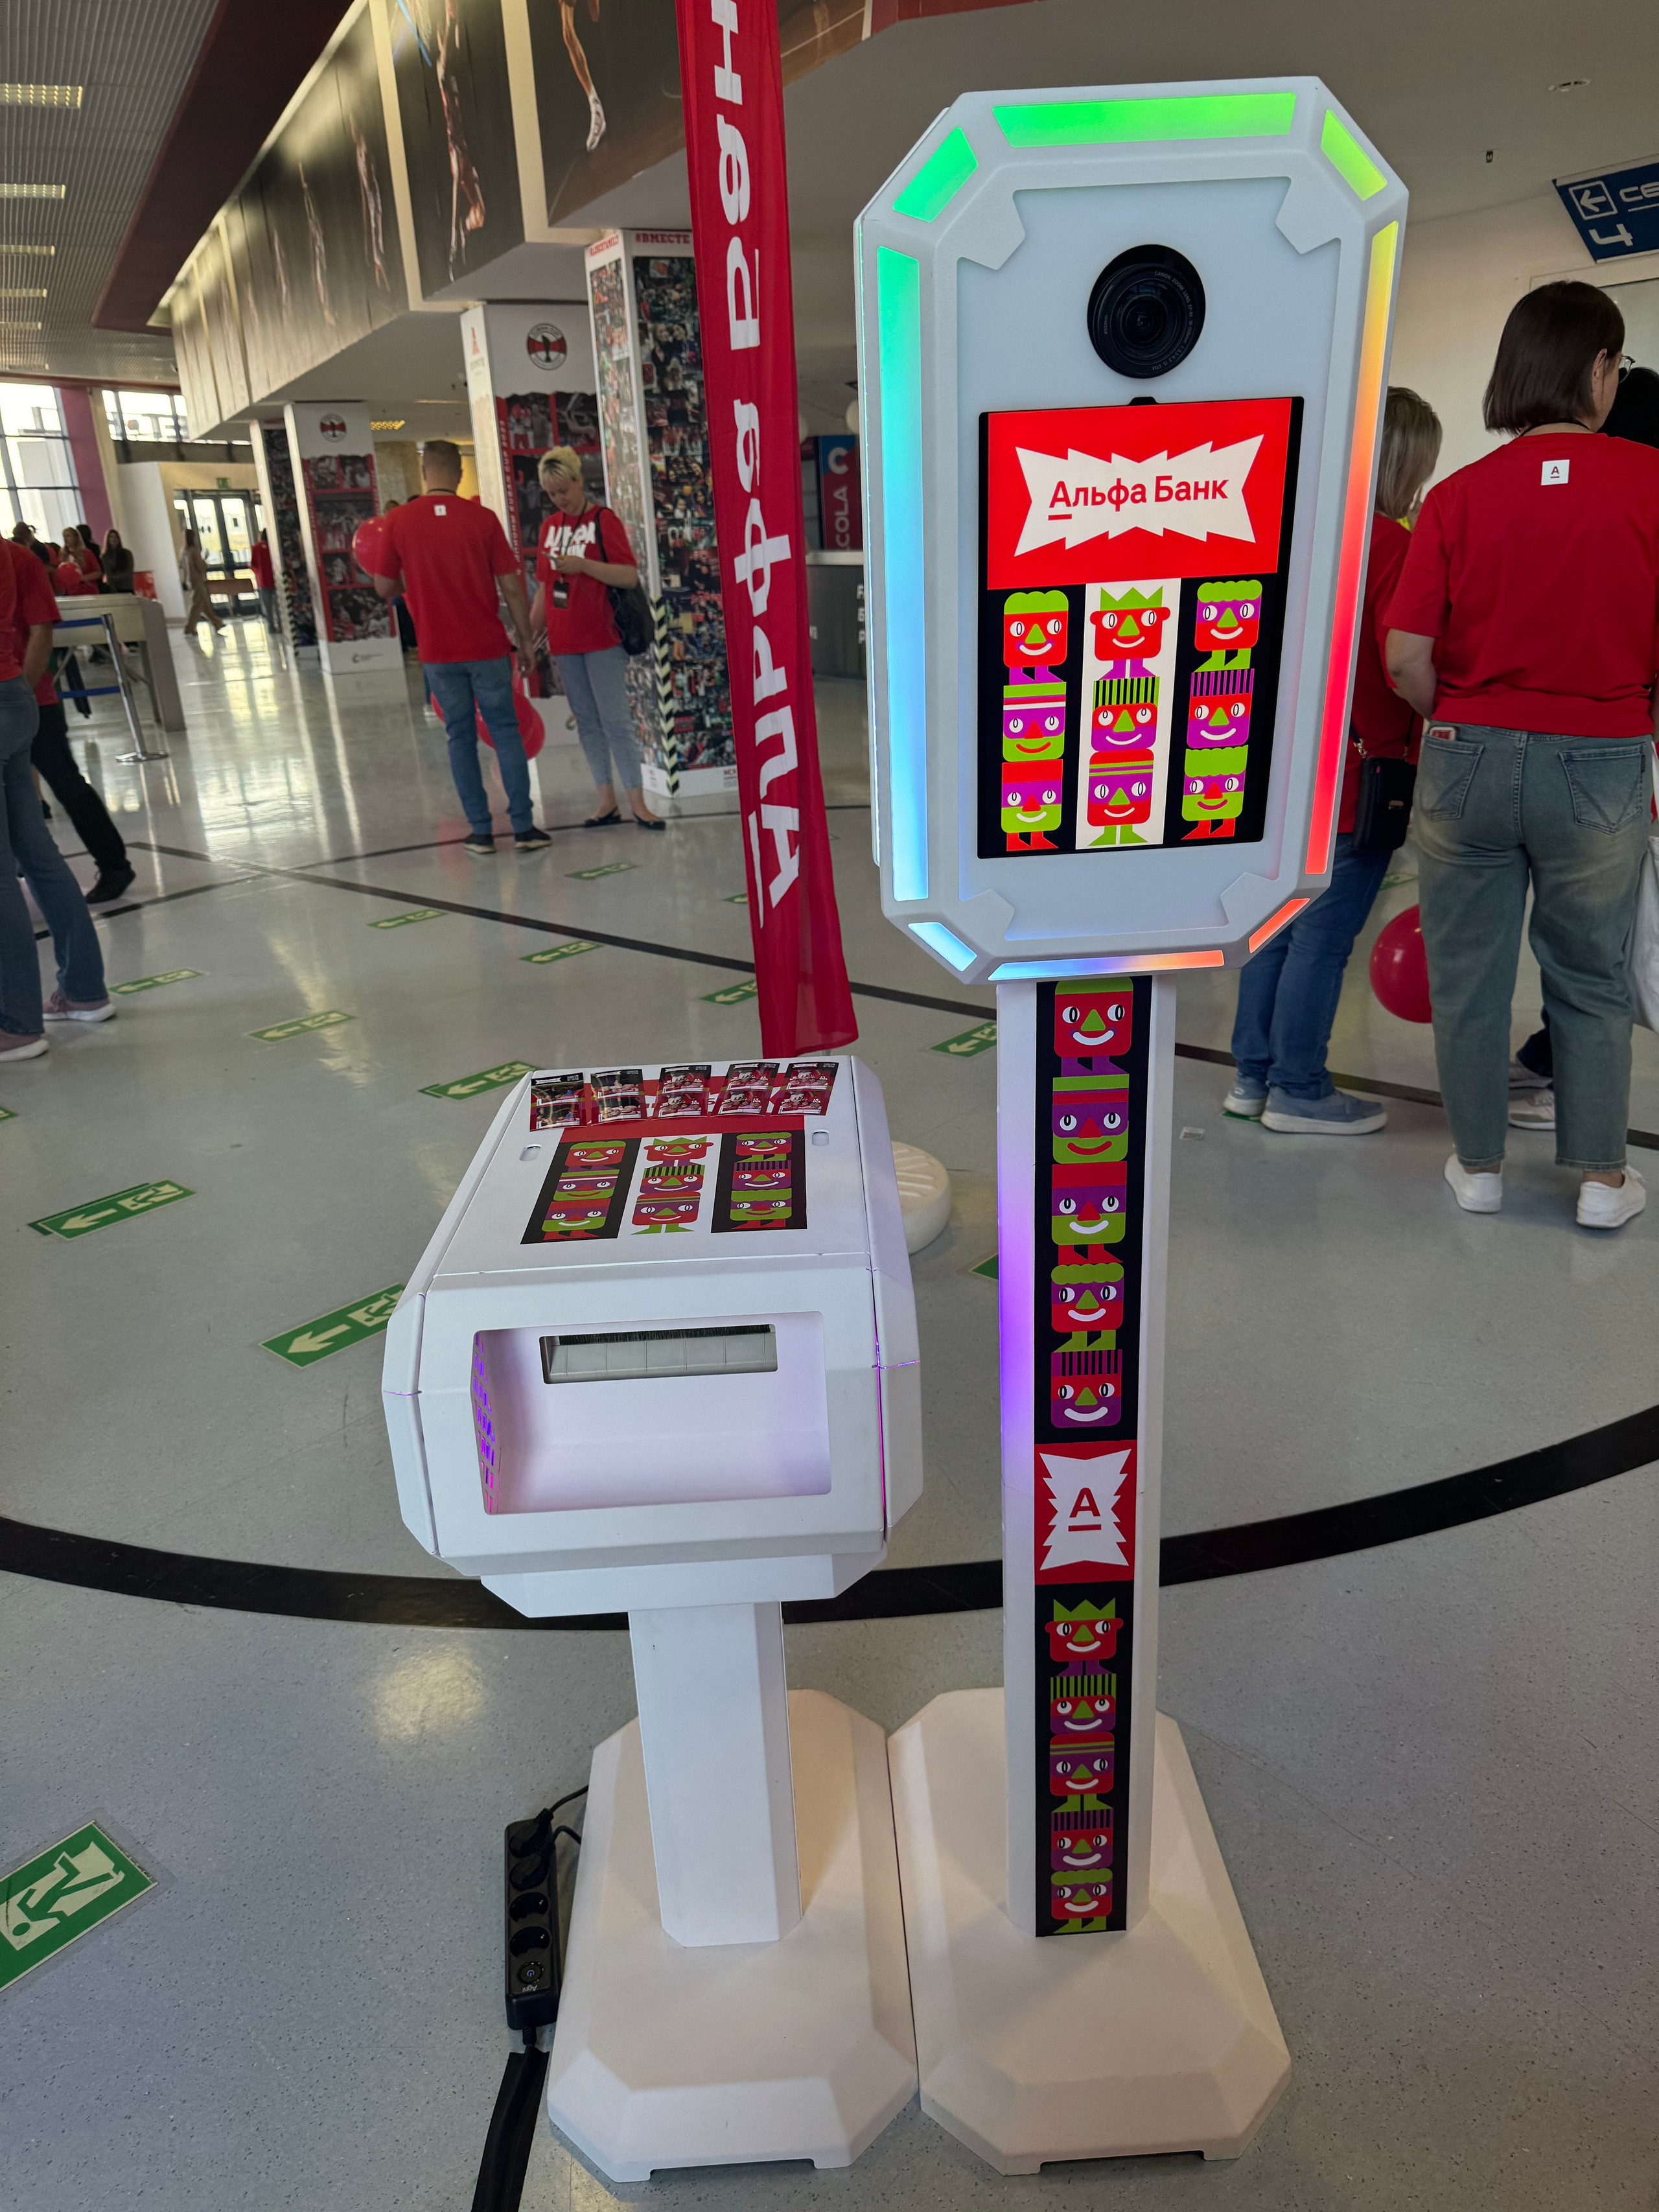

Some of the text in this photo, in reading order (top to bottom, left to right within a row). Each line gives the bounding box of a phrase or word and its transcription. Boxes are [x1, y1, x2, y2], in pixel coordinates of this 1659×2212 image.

[1589, 224, 1633, 246] 4
[1154, 271, 1172, 279] CANON
[1172, 277, 1185, 290] ZOOM
[1550, 466, 1560, 475] А
[1049, 475, 1229, 513] Альфа Банк
[1069, 1487, 1101, 1519] А
